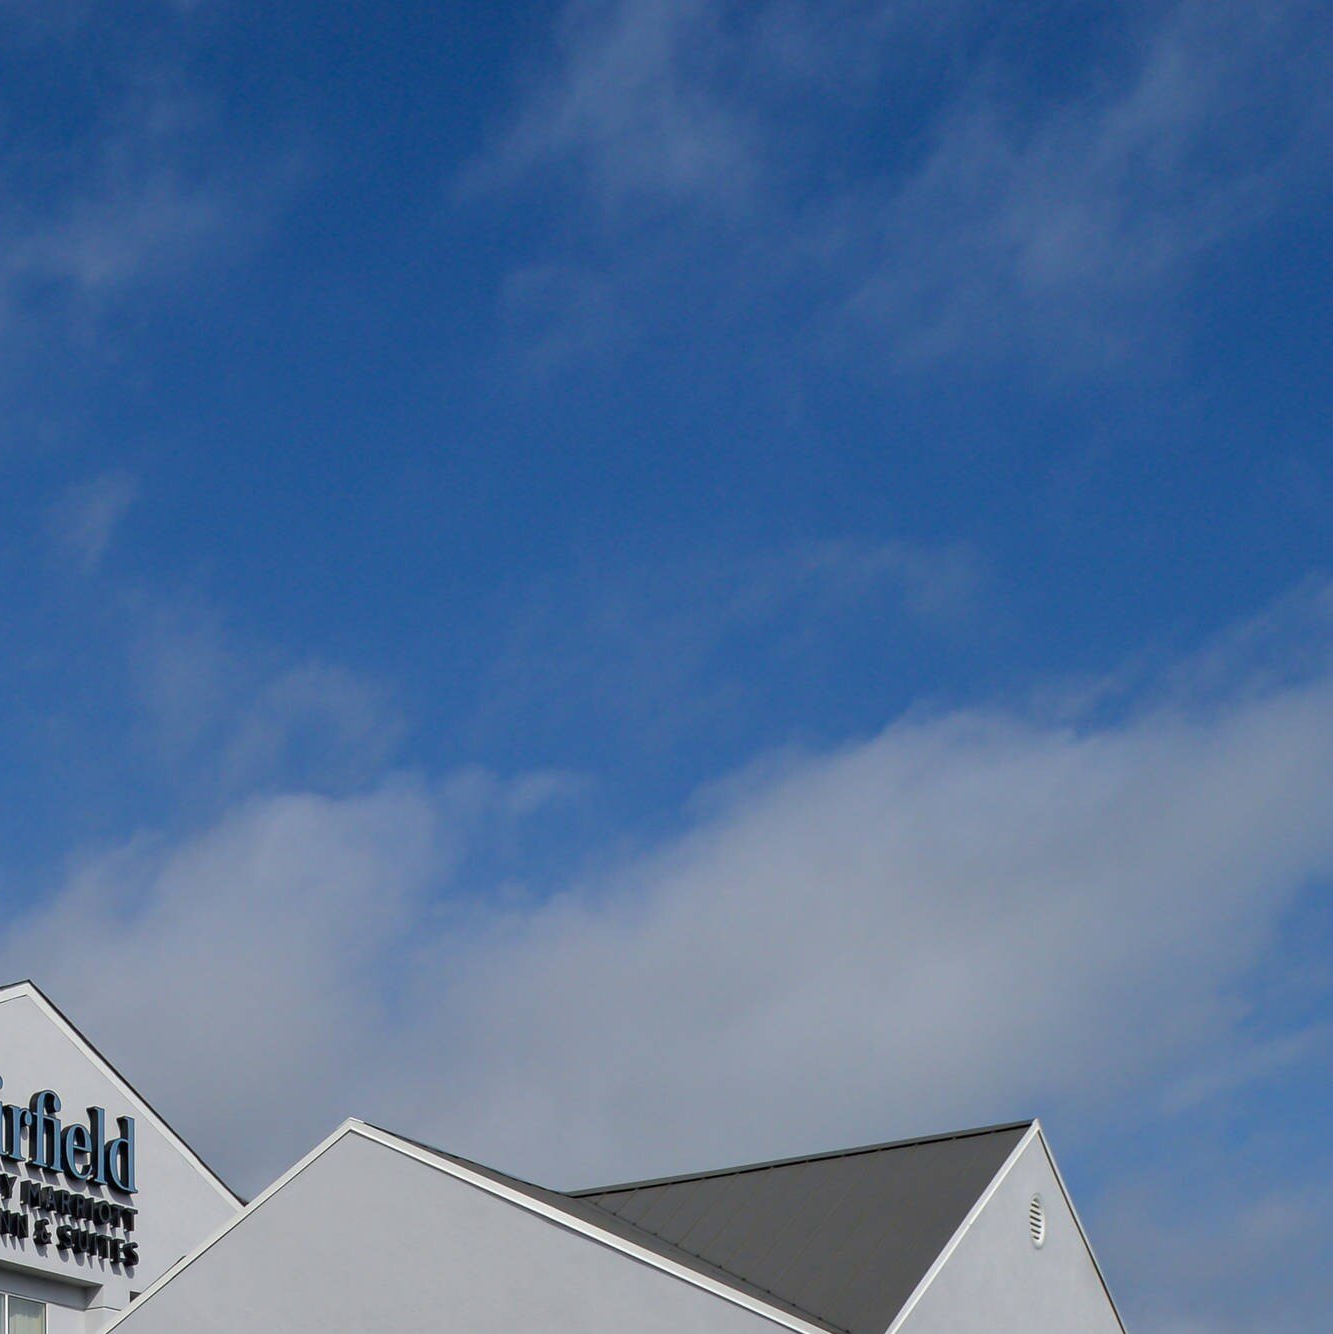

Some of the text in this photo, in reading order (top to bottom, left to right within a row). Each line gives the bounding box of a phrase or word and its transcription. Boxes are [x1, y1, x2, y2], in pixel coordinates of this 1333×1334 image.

[20, 1180, 138, 1231] MARRIOTT
[33, 1218, 52, 1245] &
[57, 1224, 139, 1267] SUITES
